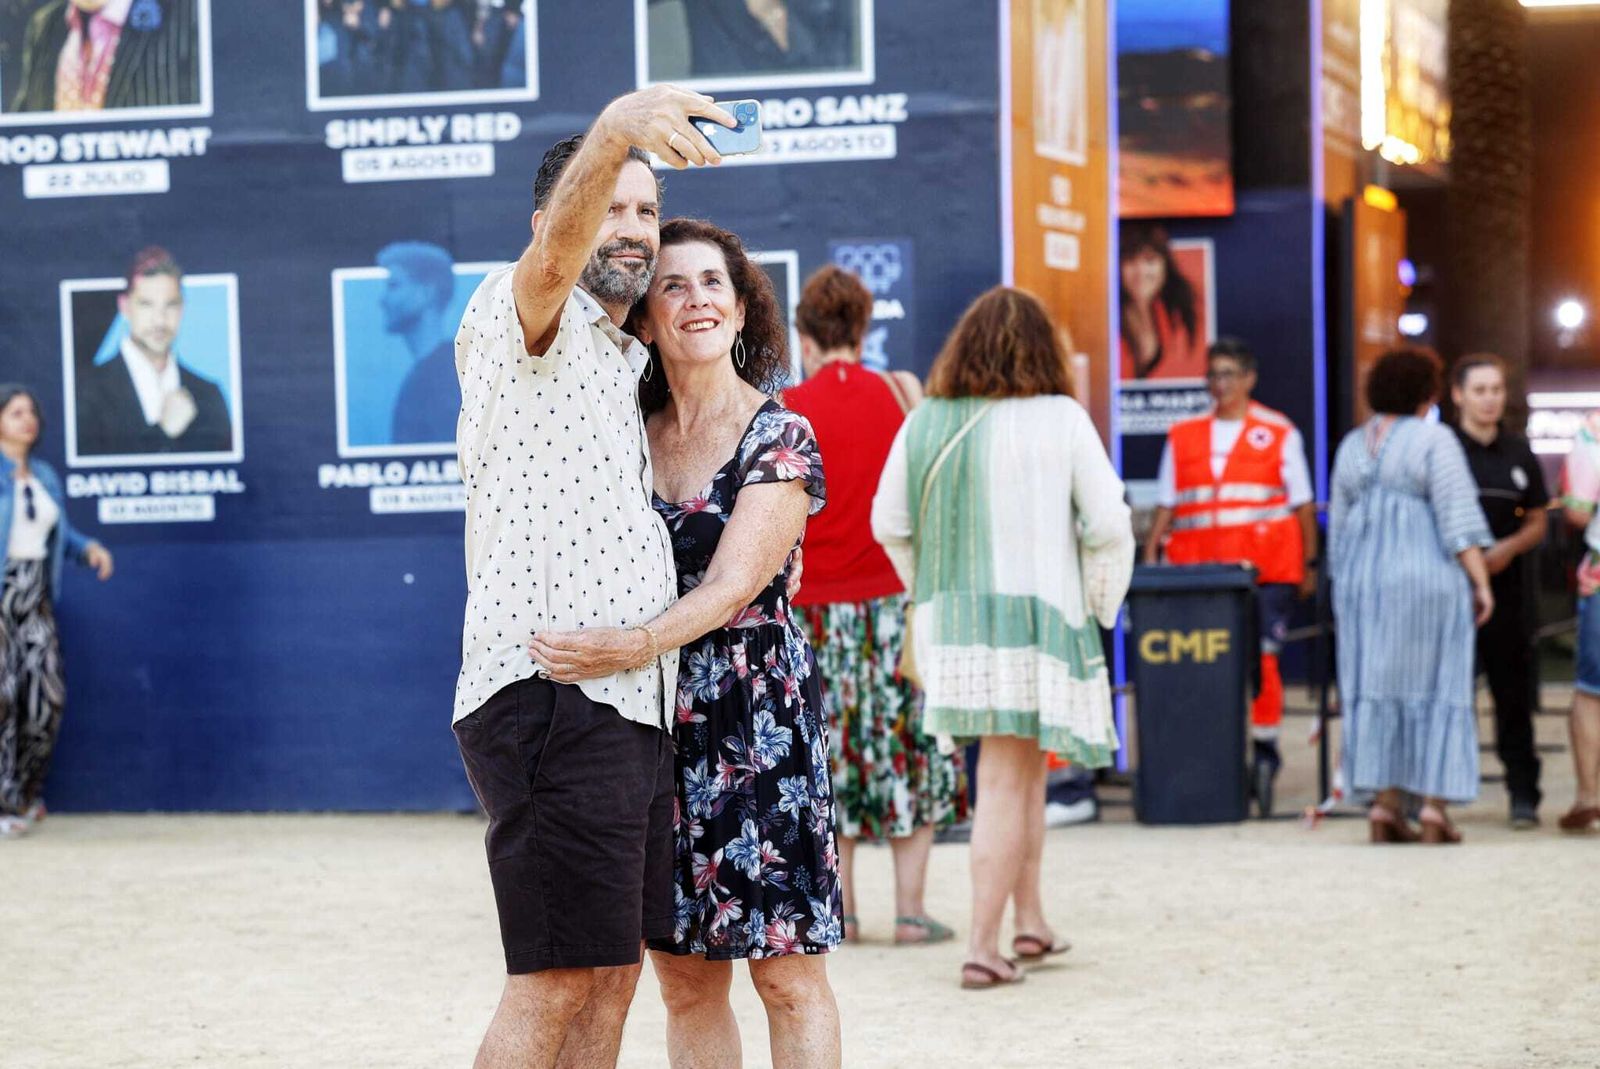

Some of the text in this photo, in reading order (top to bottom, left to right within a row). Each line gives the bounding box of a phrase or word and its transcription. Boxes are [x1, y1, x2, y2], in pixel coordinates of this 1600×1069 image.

[815, 93, 908, 126] SANZ
[60, 126, 212, 162] STEWART
[325, 112, 523, 149] SIMPLY RED
[789, 134, 886, 152] AGOSTO
[391, 151, 483, 169] AGOSTO
[66, 469, 246, 498] DAVID BISBAL
[318, 459, 463, 489] PABLO ALB
[1139, 629, 1230, 664] CMF
